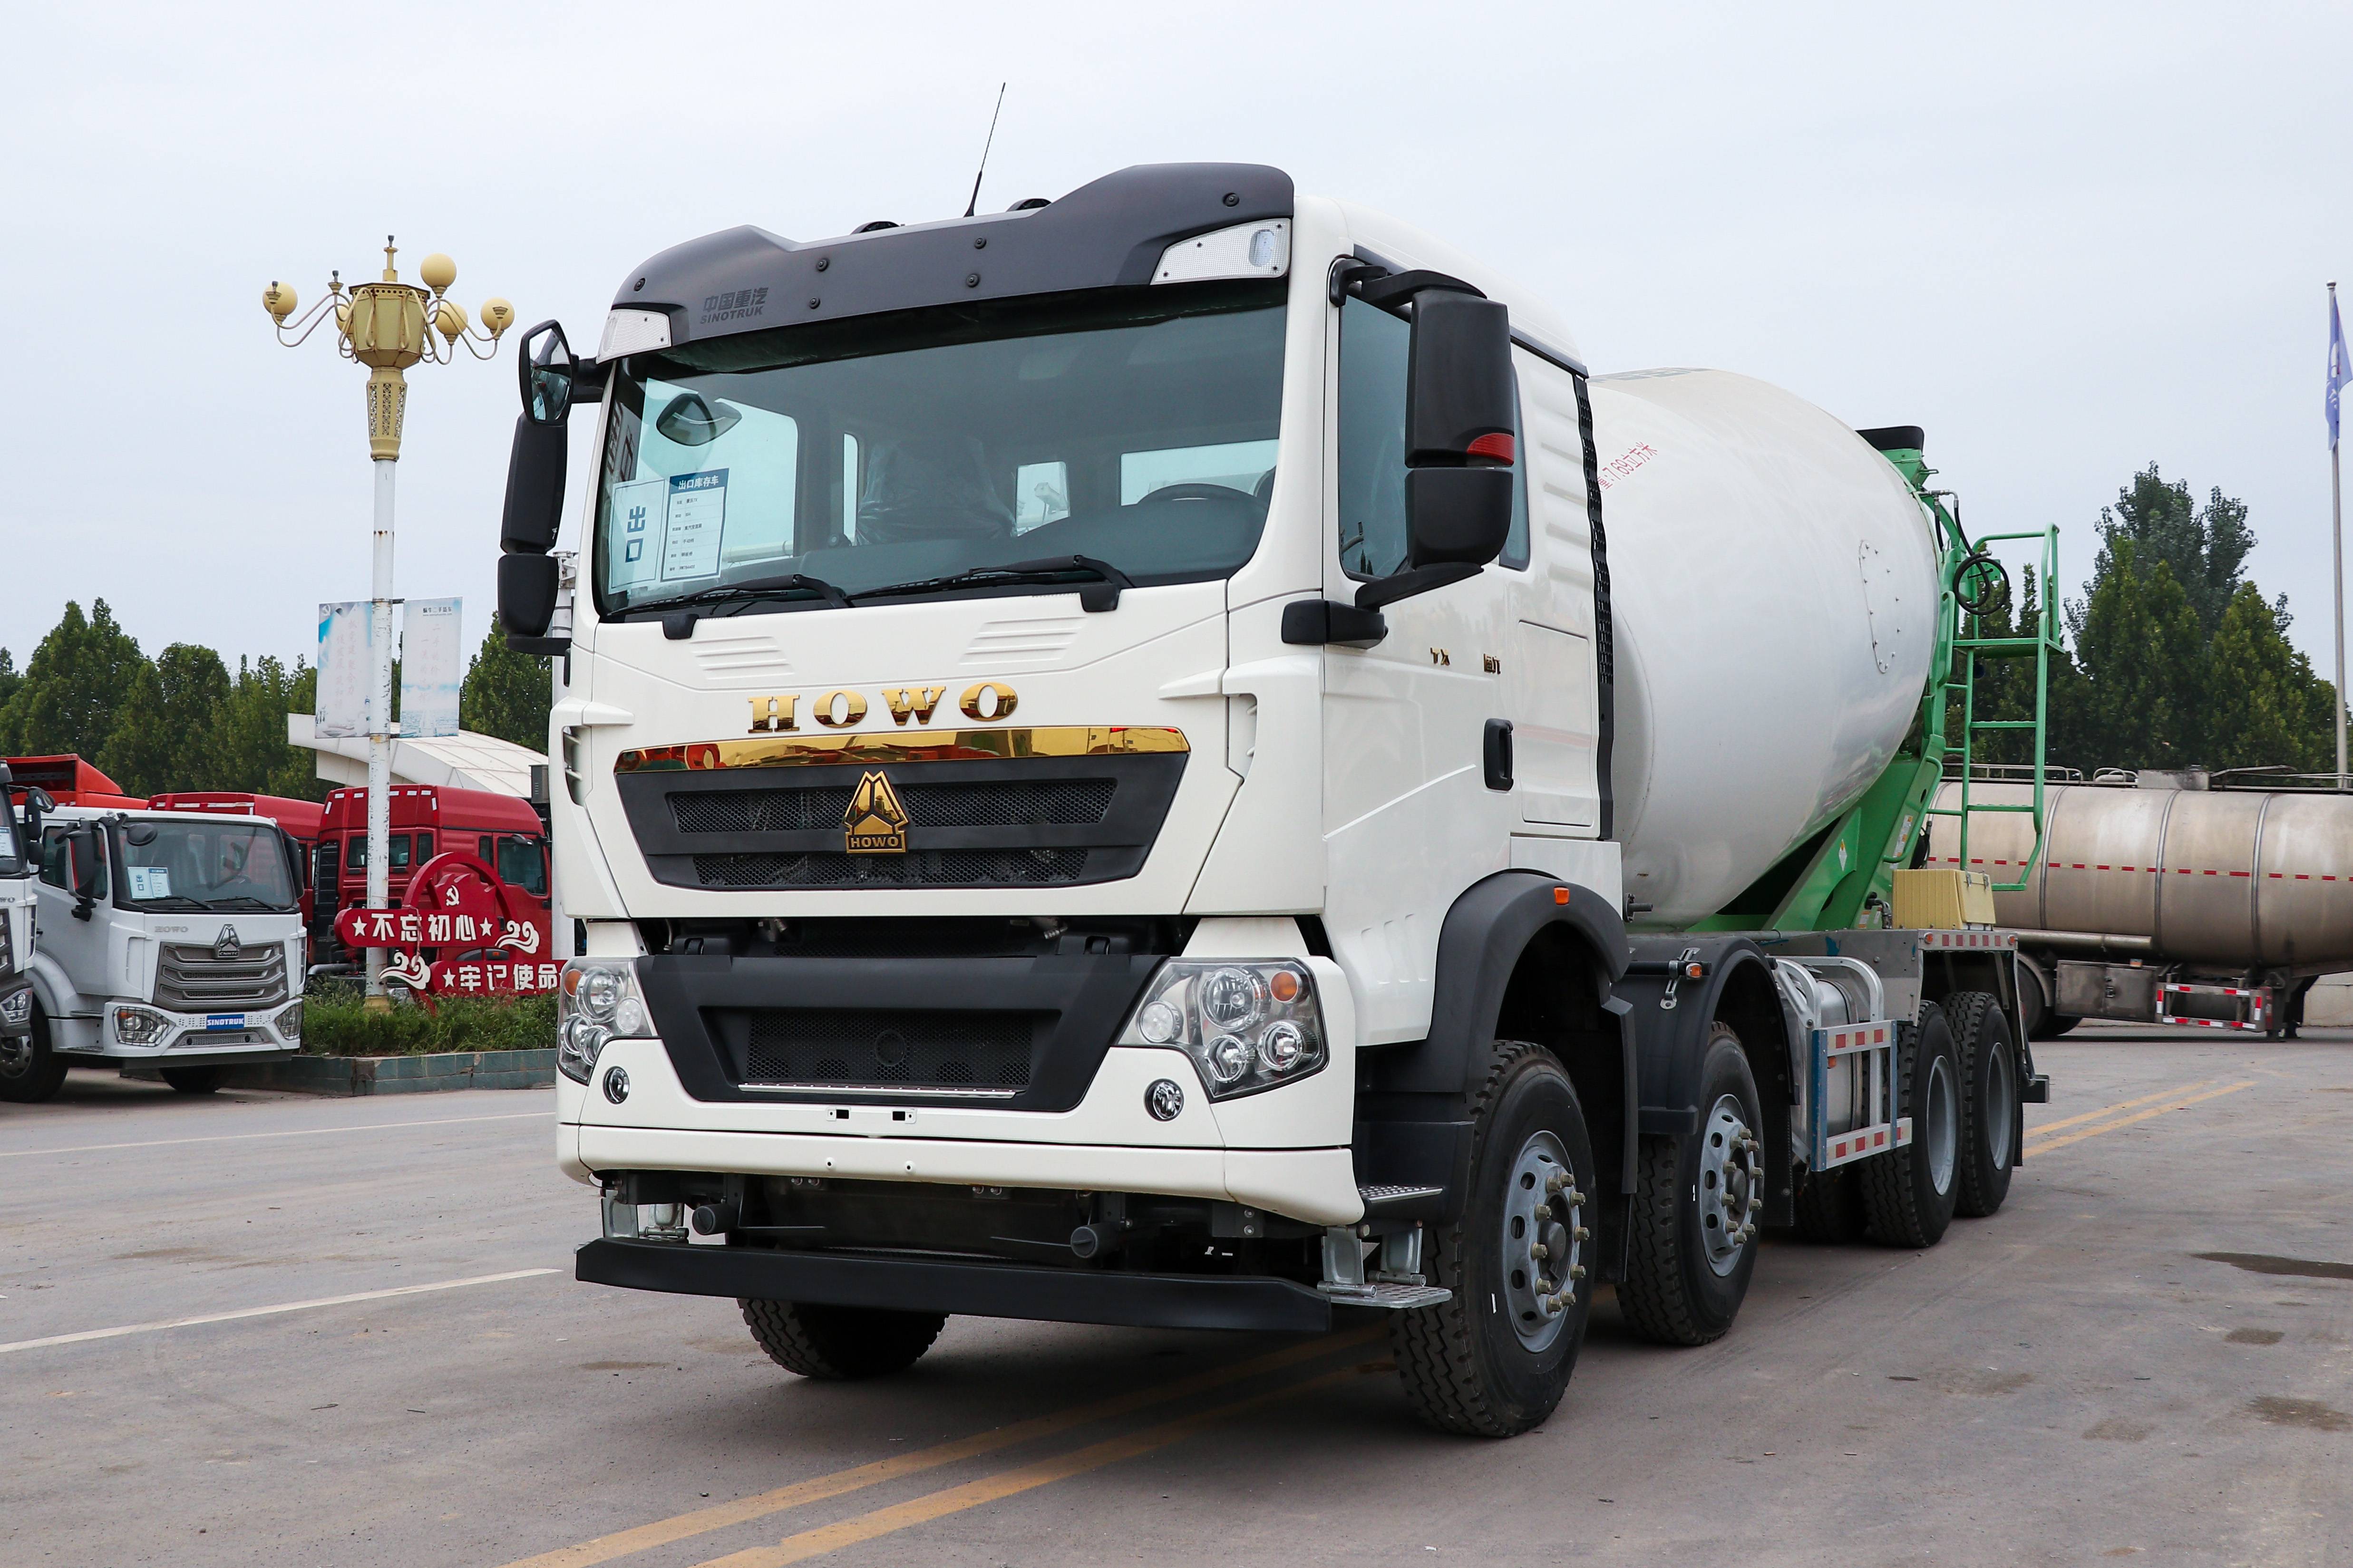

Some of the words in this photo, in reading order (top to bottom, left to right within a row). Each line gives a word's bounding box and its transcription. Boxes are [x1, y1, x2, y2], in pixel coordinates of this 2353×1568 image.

[704, 288, 768, 311] 中国重汽
[700, 306, 764, 324] SINOTRUK
[678, 475, 719, 490] 出口库存车
[625, 505, 646, 563] 出口
[748, 682, 1018, 734] HOWO
[850, 836, 900, 849] HOWO
[371, 913, 477, 942] 不忘初心
[458, 963, 558, 991] 牢记使命
[207, 1018, 244, 1026] SINOTRUK
